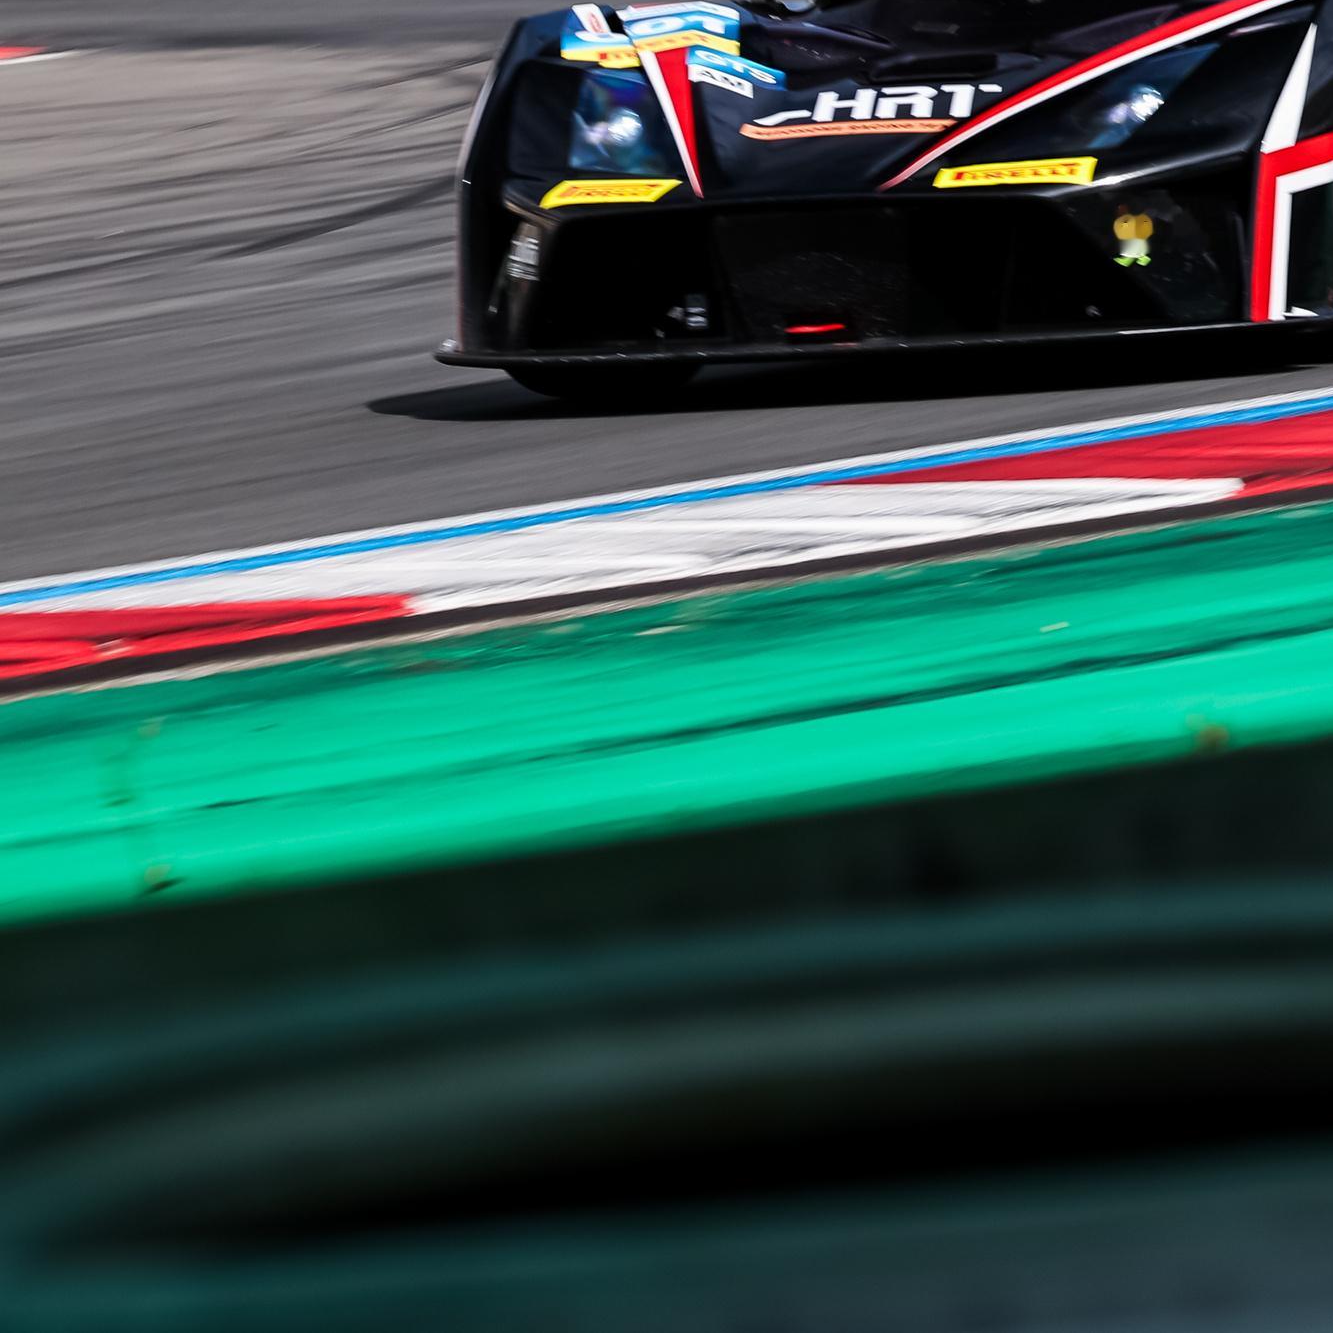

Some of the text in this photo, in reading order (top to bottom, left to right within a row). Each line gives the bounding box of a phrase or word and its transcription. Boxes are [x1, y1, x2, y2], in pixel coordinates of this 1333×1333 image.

[694, 50, 777, 85] GTS
[698, 70, 745, 91] AM
[811, 84, 1002, 122] HRT
[953, 163, 1080, 180] PIRELLI
